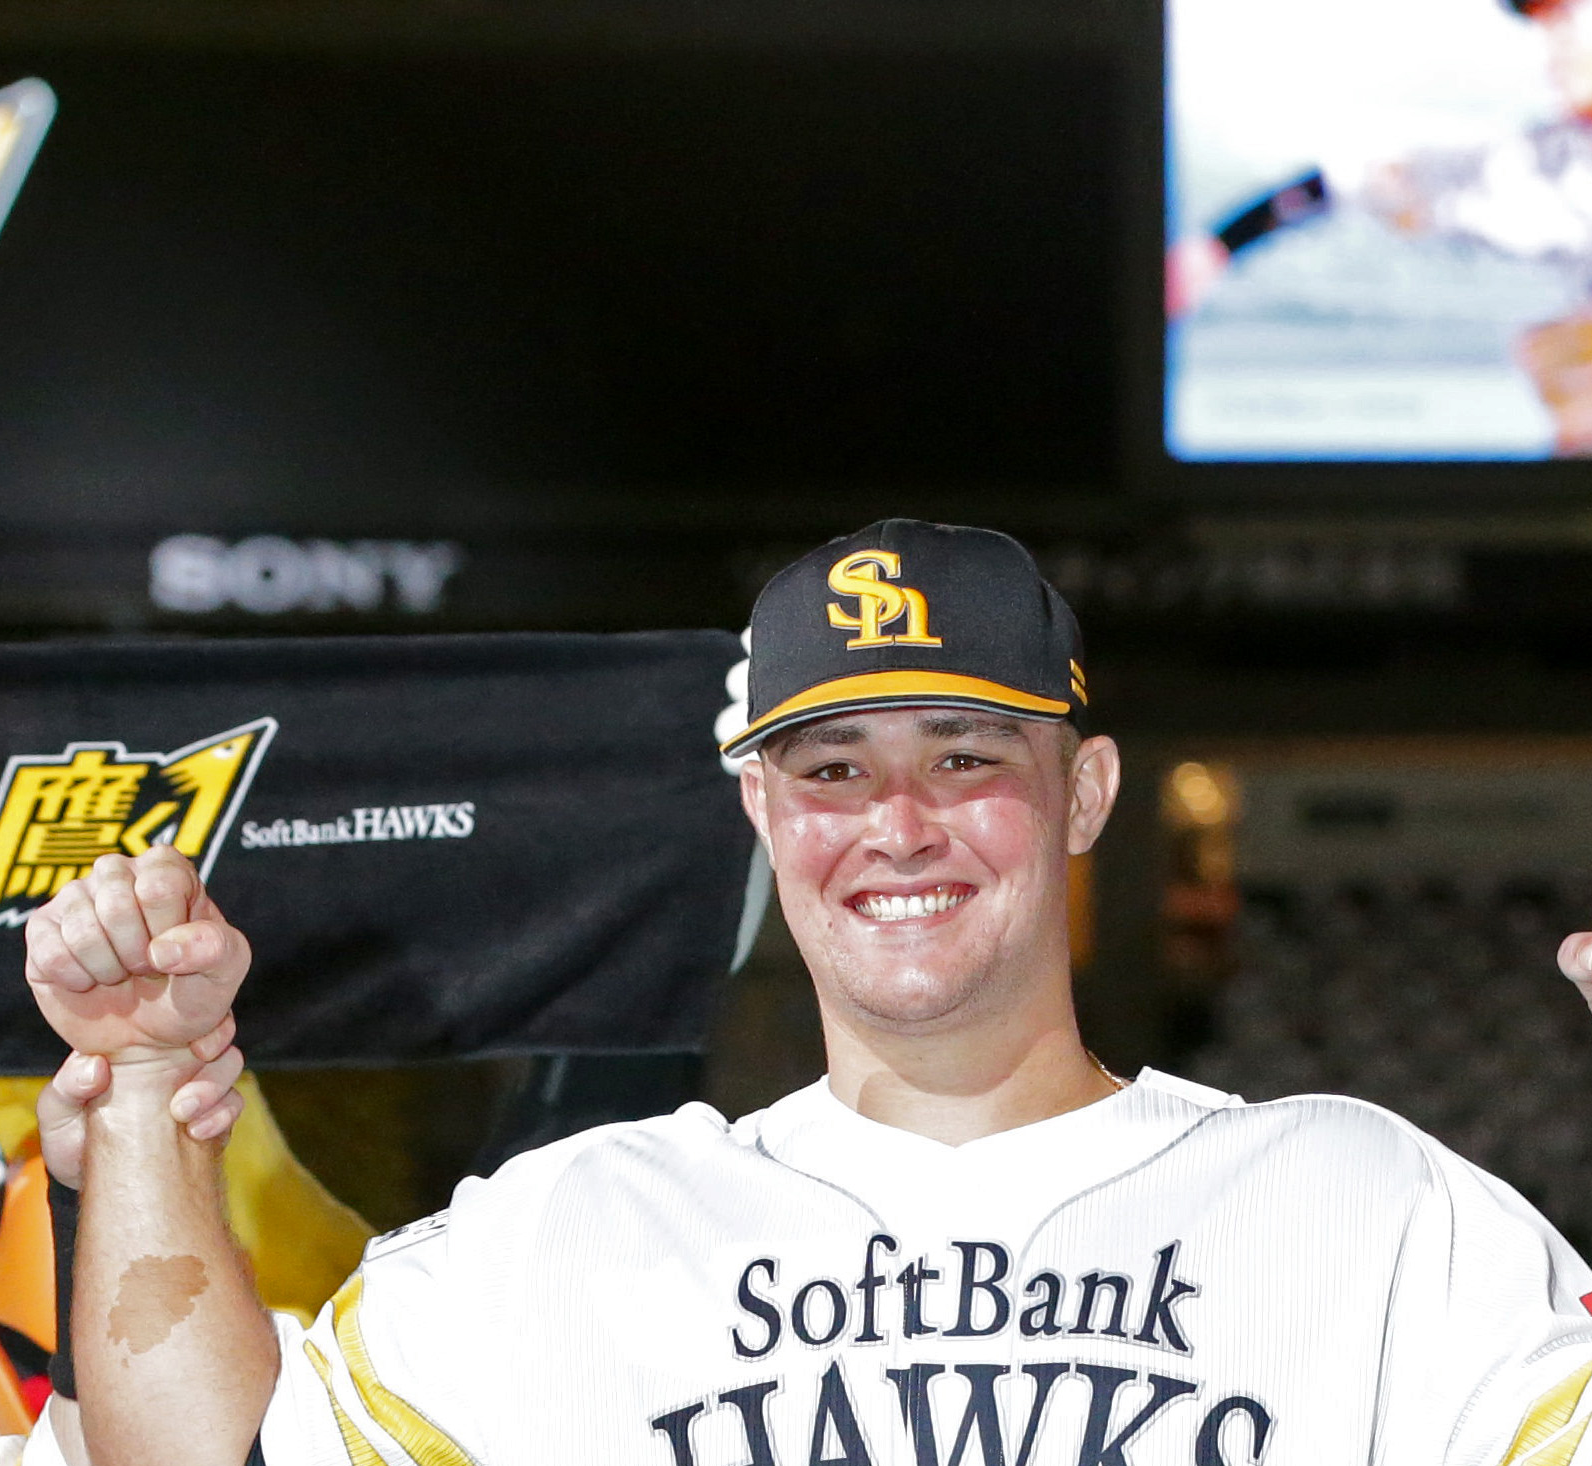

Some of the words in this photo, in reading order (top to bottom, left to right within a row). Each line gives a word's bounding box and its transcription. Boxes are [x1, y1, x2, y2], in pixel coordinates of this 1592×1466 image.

[147, 534, 459, 612] SONY
[240, 816, 353, 850] SoftBank
[352, 801, 476, 841] HAWKS
[728, 1231, 1202, 1363] SoftBank
